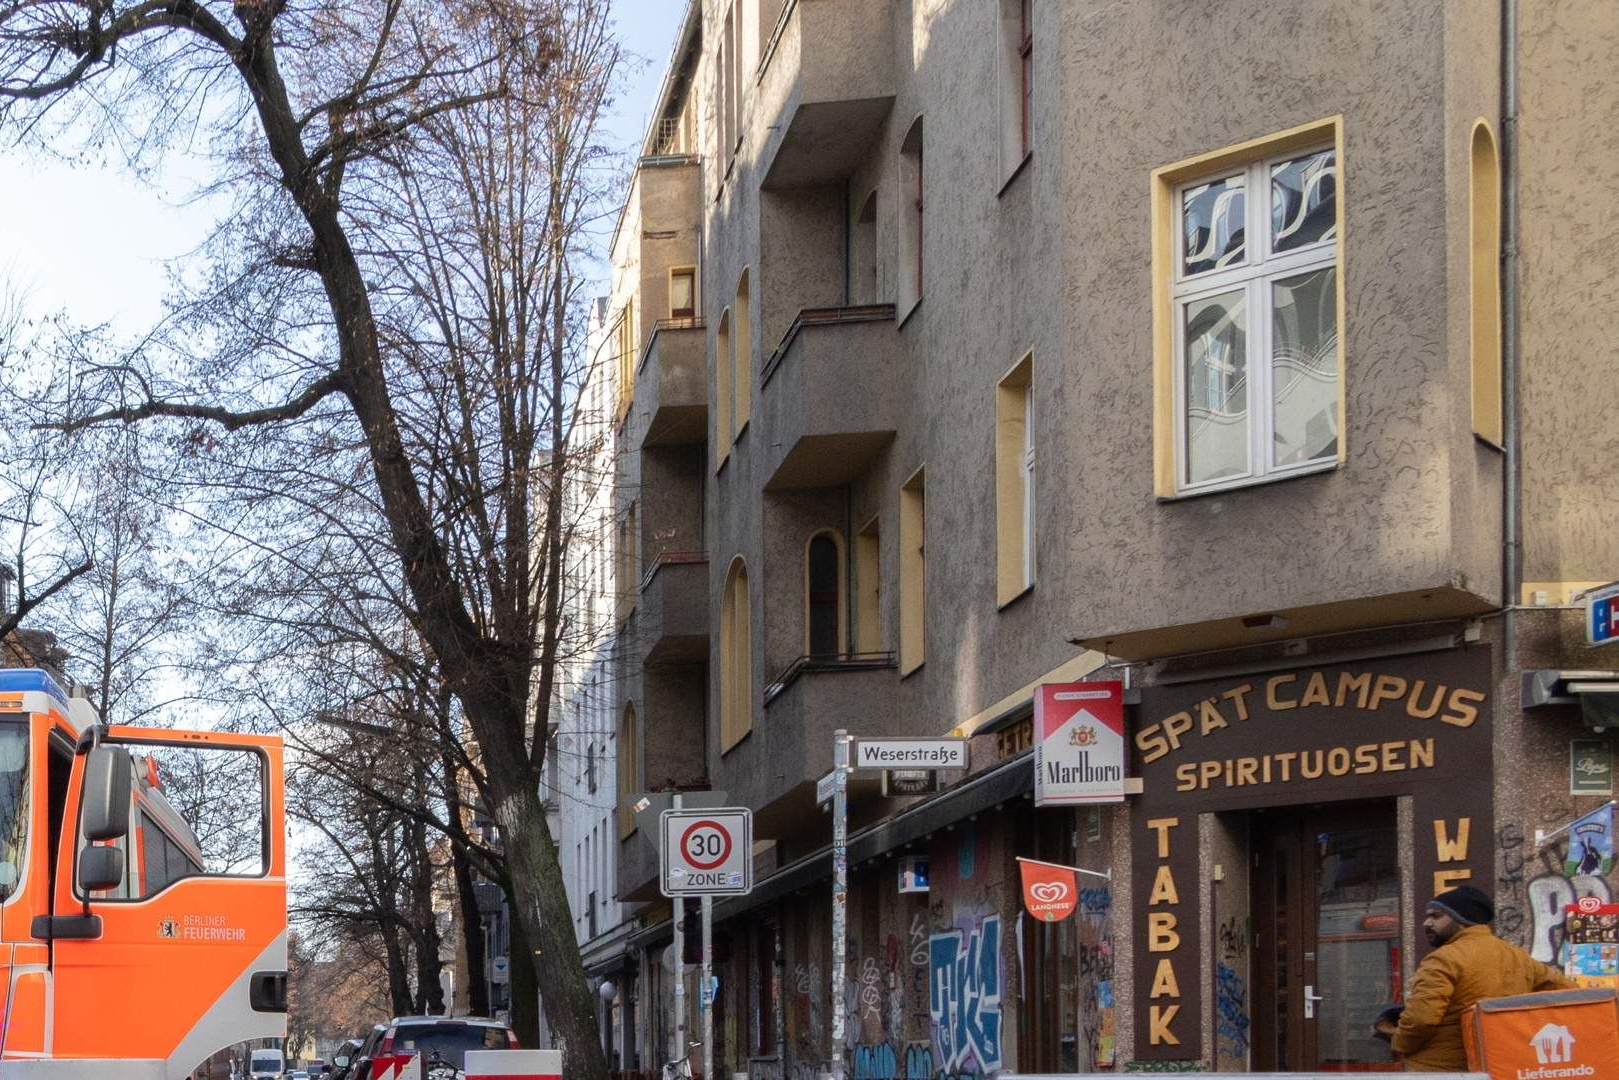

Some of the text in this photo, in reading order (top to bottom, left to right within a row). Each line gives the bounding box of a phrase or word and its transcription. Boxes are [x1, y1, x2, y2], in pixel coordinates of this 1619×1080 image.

[1134, 671, 1486, 764] SPÄT CAMPUS
[864, 746, 959, 764] Weserstraße
[1175, 738, 1435, 792] SPIRITUOSEN
[1047, 750, 1121, 785] Marlboro
[691, 833, 721, 857] 30
[687, 872, 726, 886] ZONE
[183, 914, 226, 926] BERLINER
[183, 927, 246, 941] FEUERWEHR
[1147, 817, 1182, 1046] TABAK
[1516, 1064, 1595, 1080] Lieferando
